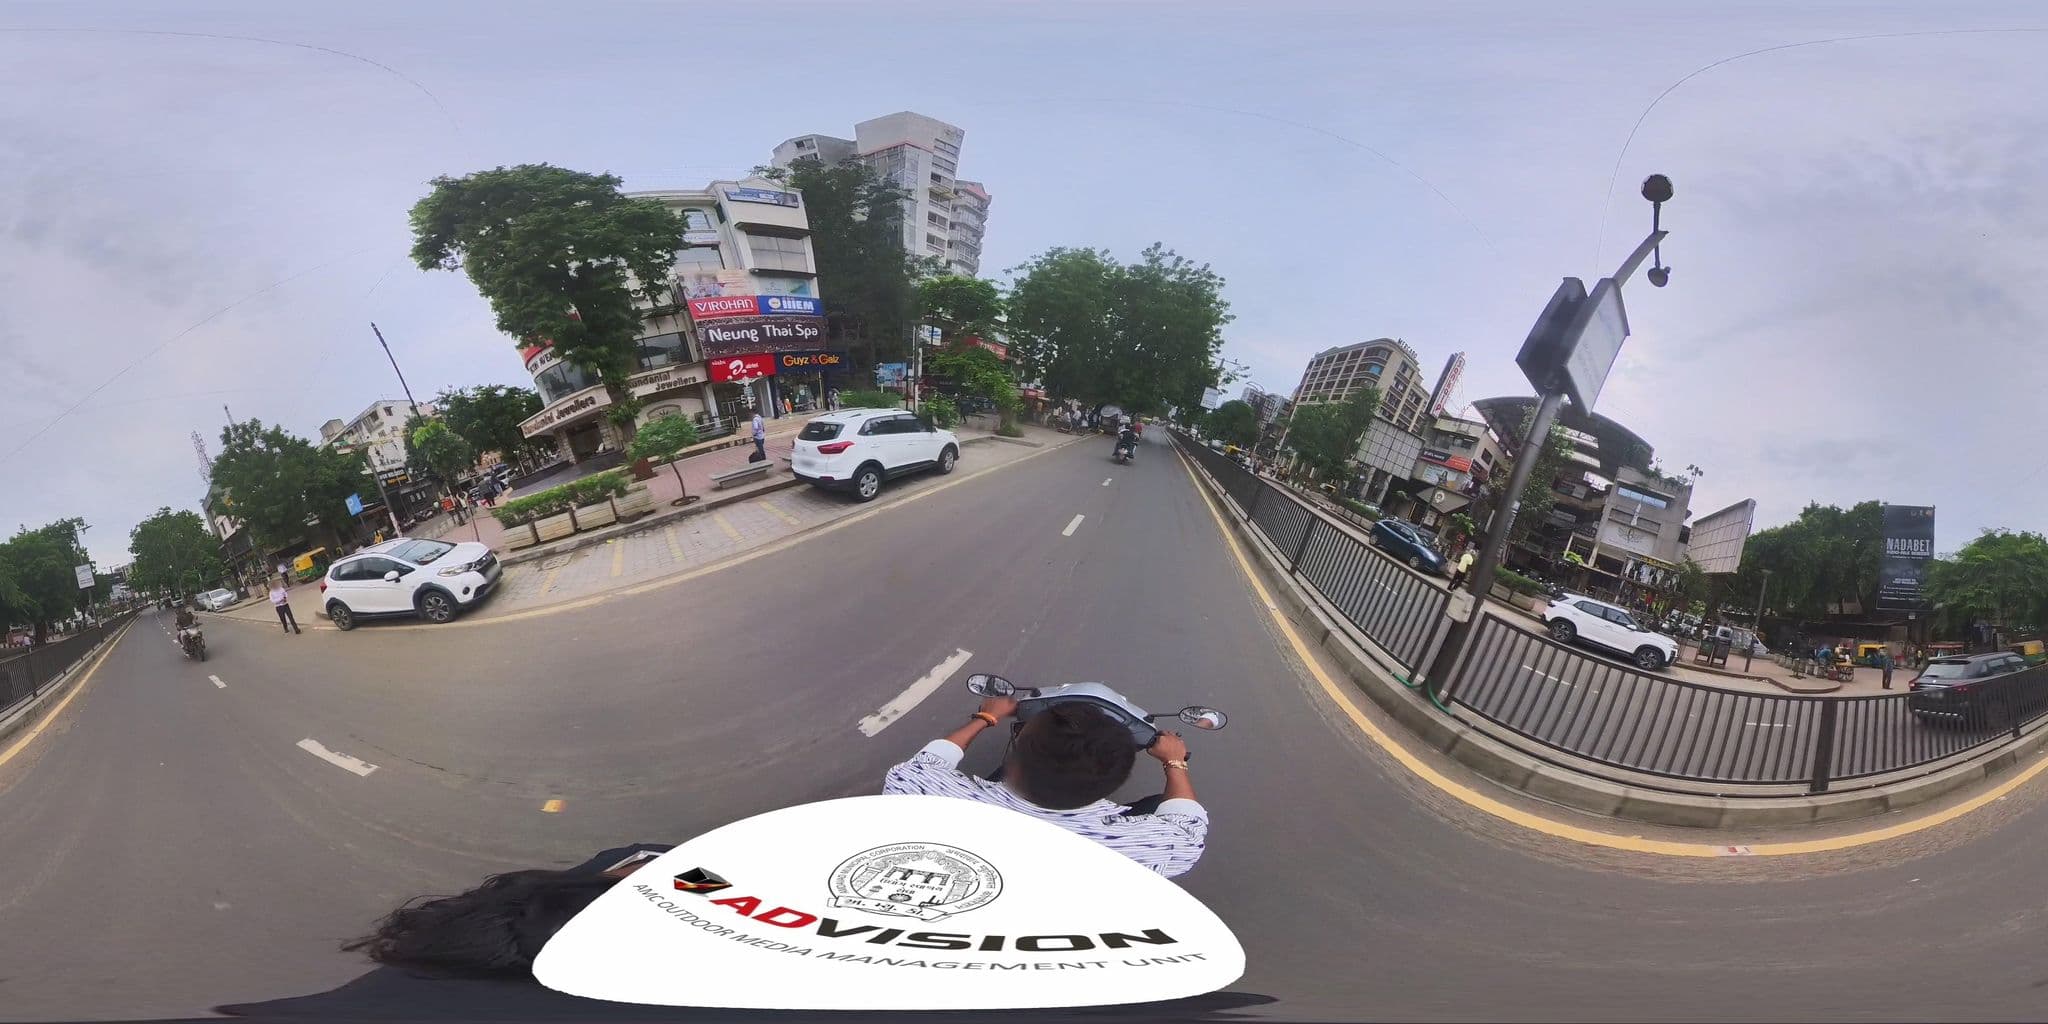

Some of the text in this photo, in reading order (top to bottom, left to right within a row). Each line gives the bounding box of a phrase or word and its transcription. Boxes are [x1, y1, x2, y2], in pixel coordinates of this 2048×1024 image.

[695, 299, 754, 313] VIROHAN
[708, 324, 818, 343] Neung Thai Spa
[783, 355, 809, 367] Guyz
[656, 376, 697, 391] Jewellers
[556, 395, 597, 420] Jewellers
[1886, 537, 1930, 552] NADABET
